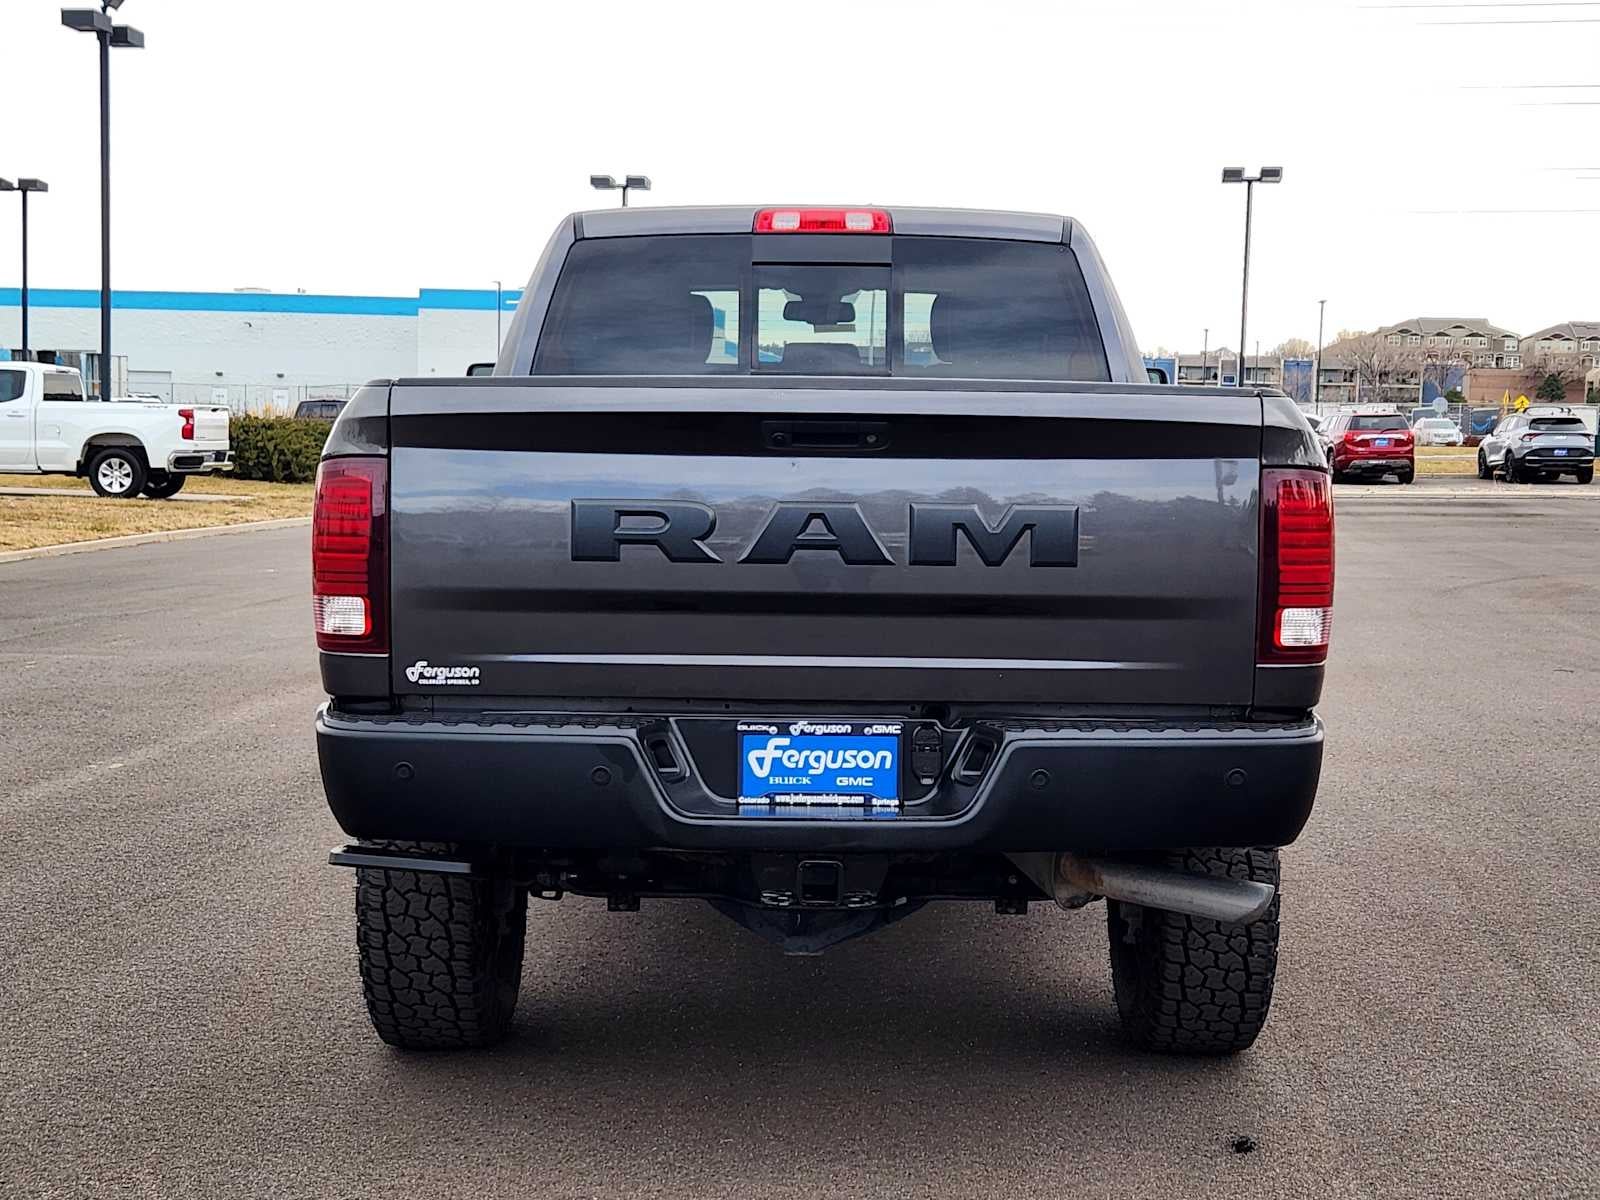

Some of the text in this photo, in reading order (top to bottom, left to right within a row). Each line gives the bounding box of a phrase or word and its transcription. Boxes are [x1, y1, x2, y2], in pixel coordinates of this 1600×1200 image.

[571, 499, 1079, 567] RAM
[405, 661, 480, 682] Ferguson
[789, 721, 852, 736] Ferguson
[872, 725, 902, 734] GMC
[747, 738, 893, 778] Ferguson
[769, 777, 812, 785] BUICK
[836, 777, 874, 786] GMC
